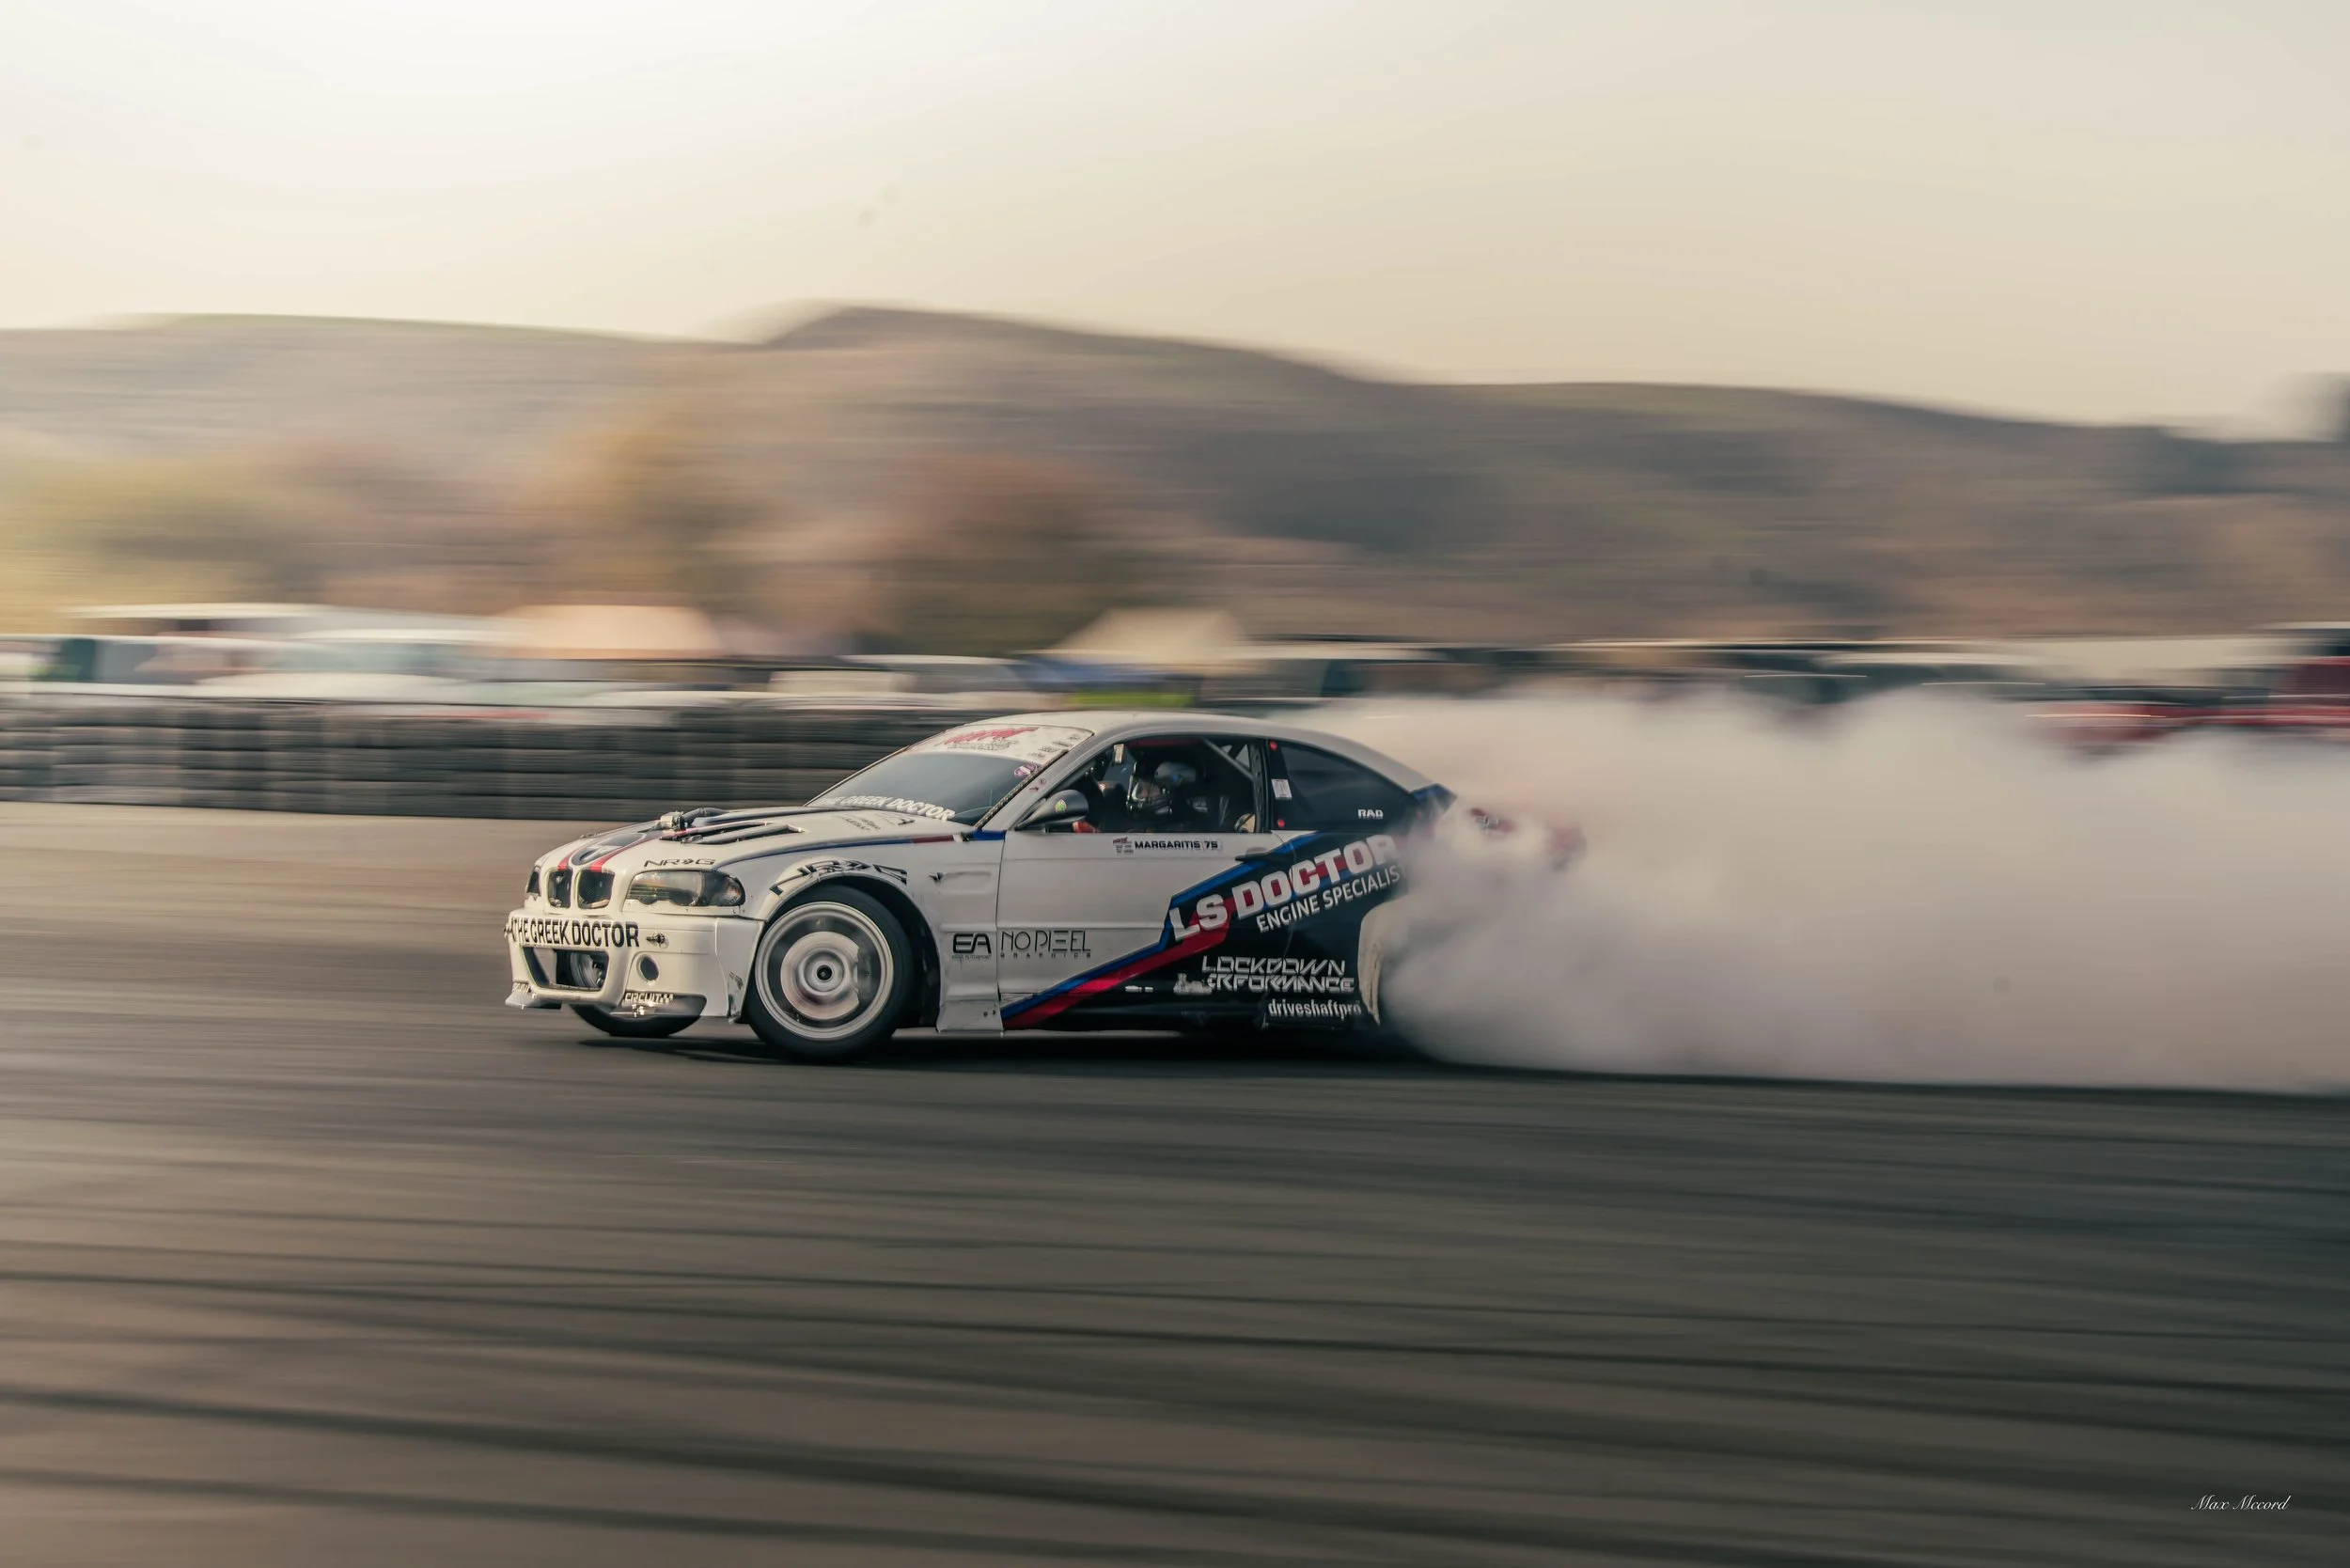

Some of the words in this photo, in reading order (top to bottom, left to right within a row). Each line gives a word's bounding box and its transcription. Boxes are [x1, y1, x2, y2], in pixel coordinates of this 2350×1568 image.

[886, 798, 956, 821] DOCTOR
[1135, 840, 1200, 850] MARGARITIS
[1204, 840, 1218, 850] 75
[1168, 893, 1228, 941] LS
[1231, 834, 1401, 920] DOCTOR
[1256, 894, 1321, 933] ENGINE
[530, 917, 570, 945] GREEK
[572, 920, 640, 948] DOCTOR
[952, 933, 992, 954] EA
[1001, 931, 1031, 951] NO
[1201, 955, 1346, 977] LOCKDOWN
[624, 992, 662, 1004] CIRCUIT
[1268, 998, 1362, 1021] driveshaftpro
